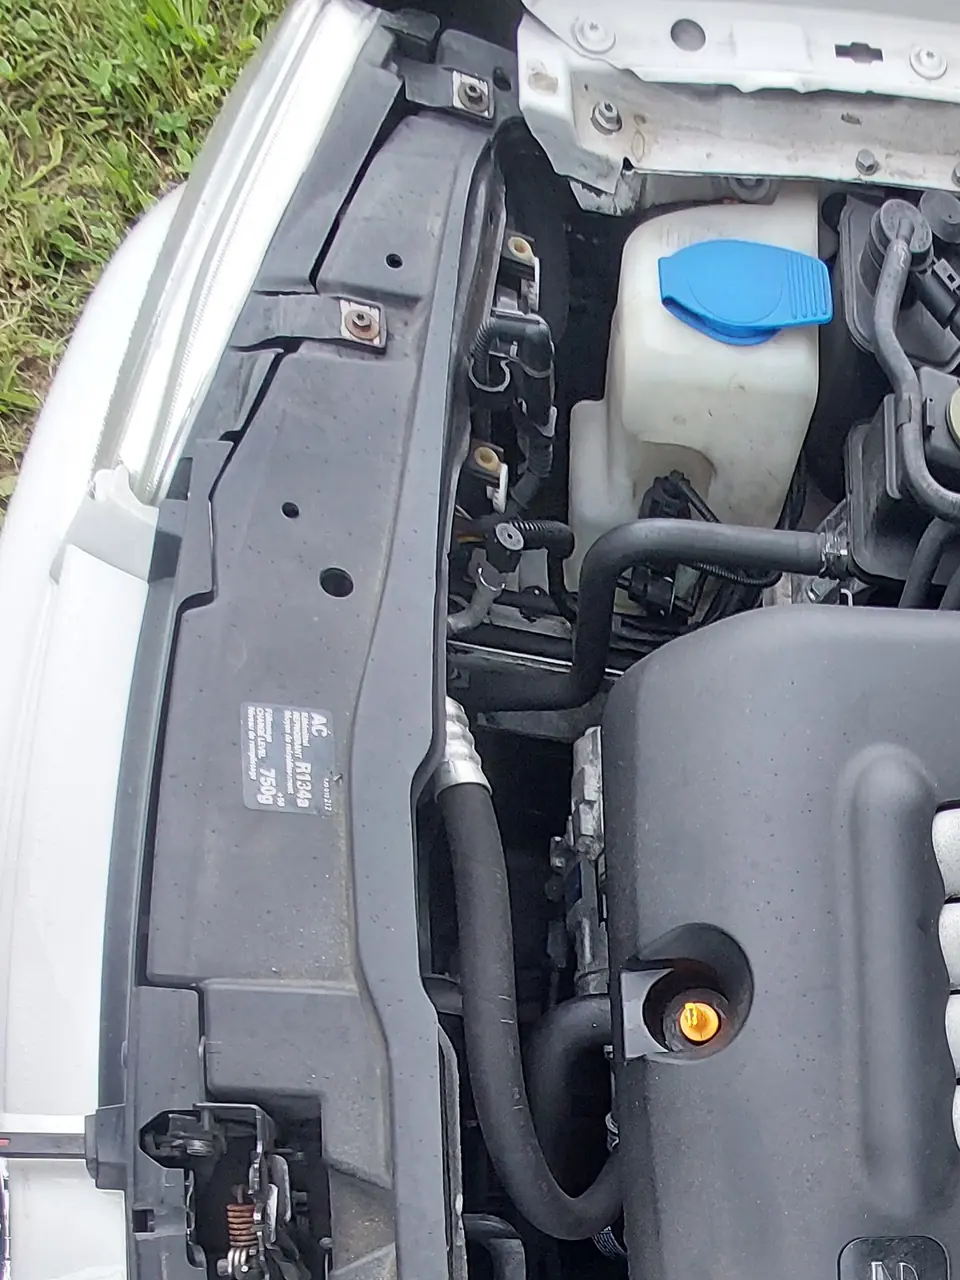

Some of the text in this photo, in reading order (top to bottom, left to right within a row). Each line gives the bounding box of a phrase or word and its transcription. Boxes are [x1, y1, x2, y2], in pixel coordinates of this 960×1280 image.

[310, 712, 328, 738] AC
[257, 736, 267, 759] LEVEL
[256, 768, 276, 805] 750g
[294, 762, 312, 807] R134a
